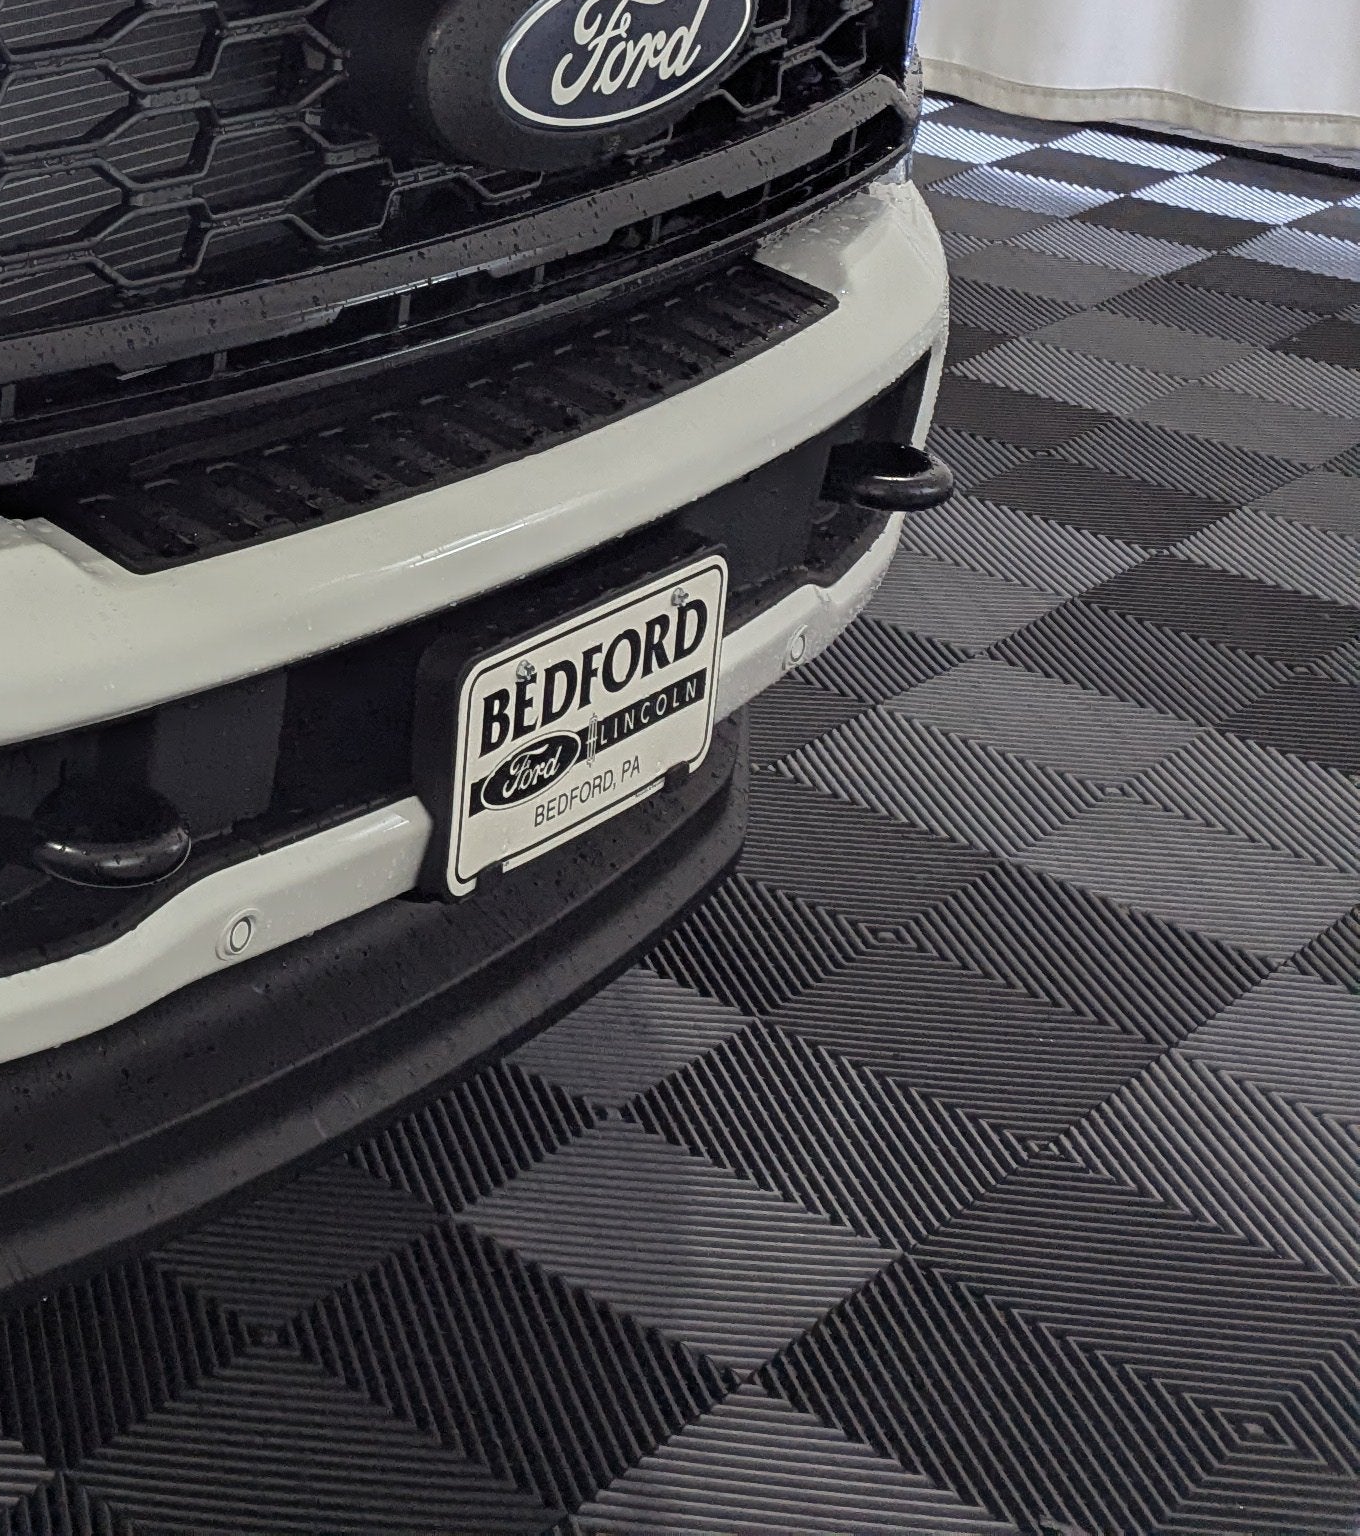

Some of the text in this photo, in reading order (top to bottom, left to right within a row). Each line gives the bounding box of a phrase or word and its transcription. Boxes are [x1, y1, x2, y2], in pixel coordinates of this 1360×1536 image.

[479, 597, 709, 759] BEDFORD
[500, 677, 699, 799] Ford LINCOLN
[533, 773, 618, 828] BEDFORD,
[619, 755, 641, 786] PA
